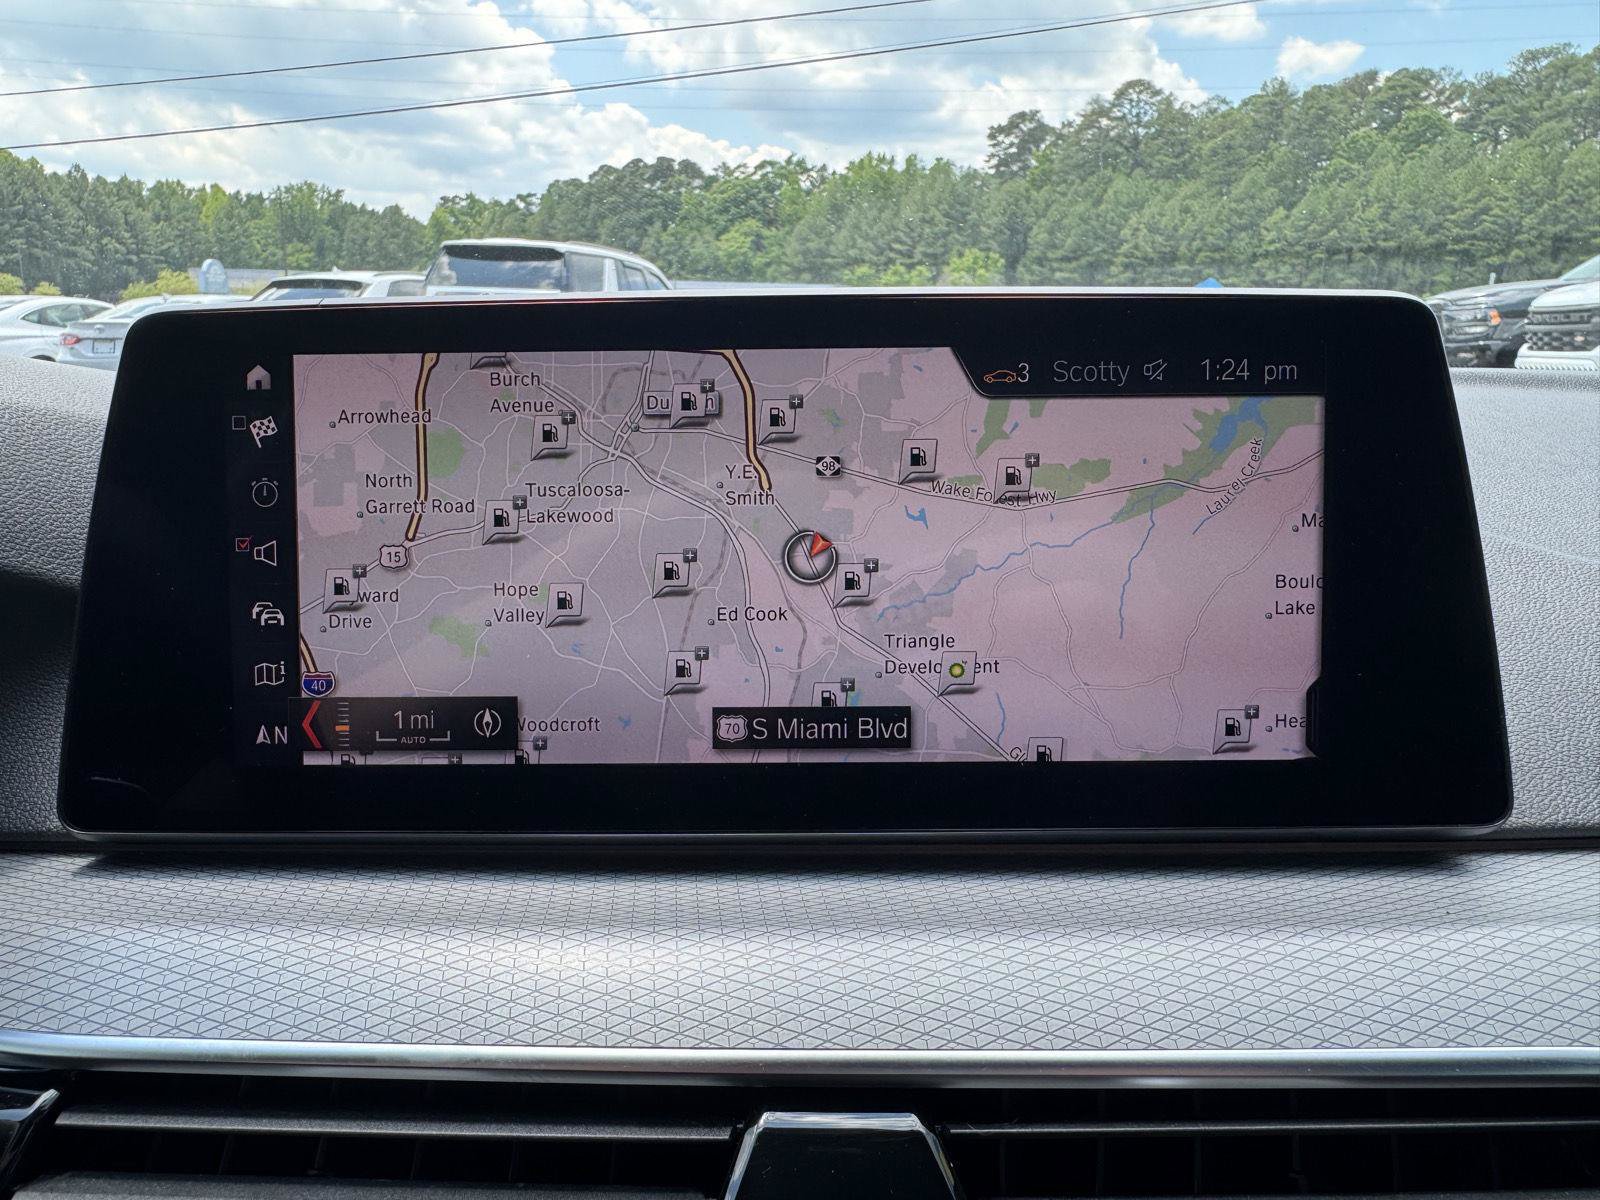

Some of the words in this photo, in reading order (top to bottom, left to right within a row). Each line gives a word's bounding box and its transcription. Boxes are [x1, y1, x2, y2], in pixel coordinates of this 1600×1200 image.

[1017, 364, 1030, 383] 3
[1053, 360, 1130, 386] Scotty
[1200, 359, 1250, 382] 1:24
[1264, 363, 1298, 384] pm
[490, 372, 541, 388] Burch
[490, 399, 555, 413] Avenue
[338, 409, 432, 424] Arrowhead
[725, 464, 757, 479] Y.E.
[821, 460, 836, 472] 98
[365, 473, 413, 488] North
[1205, 478, 1246, 515] Laurel
[1240, 437, 1263, 477] Creek
[525, 482, 630, 498] Tuscaloosa-
[725, 490, 775, 506] Smith
[930, 480, 971, 498] Wake
[976, 487, 1023, 507] Foest
[1028, 490, 1057, 505] Hwy
[365, 499, 426, 514] Garrett
[432, 499, 475, 514] Road
[526, 508, 614, 524] Lakewood
[386, 551, 401, 563] 15
[357, 588, 400, 603] ward
[494, 582, 539, 601] Hope
[717, 606, 738, 622] Ed
[744, 606, 788, 622] Cook
[1275, 600, 1316, 615] Lake
[329, 614, 373, 629] Drive
[493, 608, 545, 626] Valley
[884, 633, 956, 653] Triangle
[310, 679, 326, 692] 40
[393, 710, 404, 729] 1
[410, 710, 435, 729] mi
[724, 722, 740, 735] 70
[752, 718, 768, 739] S
[777, 717, 849, 739] Miami
[858, 717, 908, 739] Blvd
[400, 736, 427, 744] AUTO
